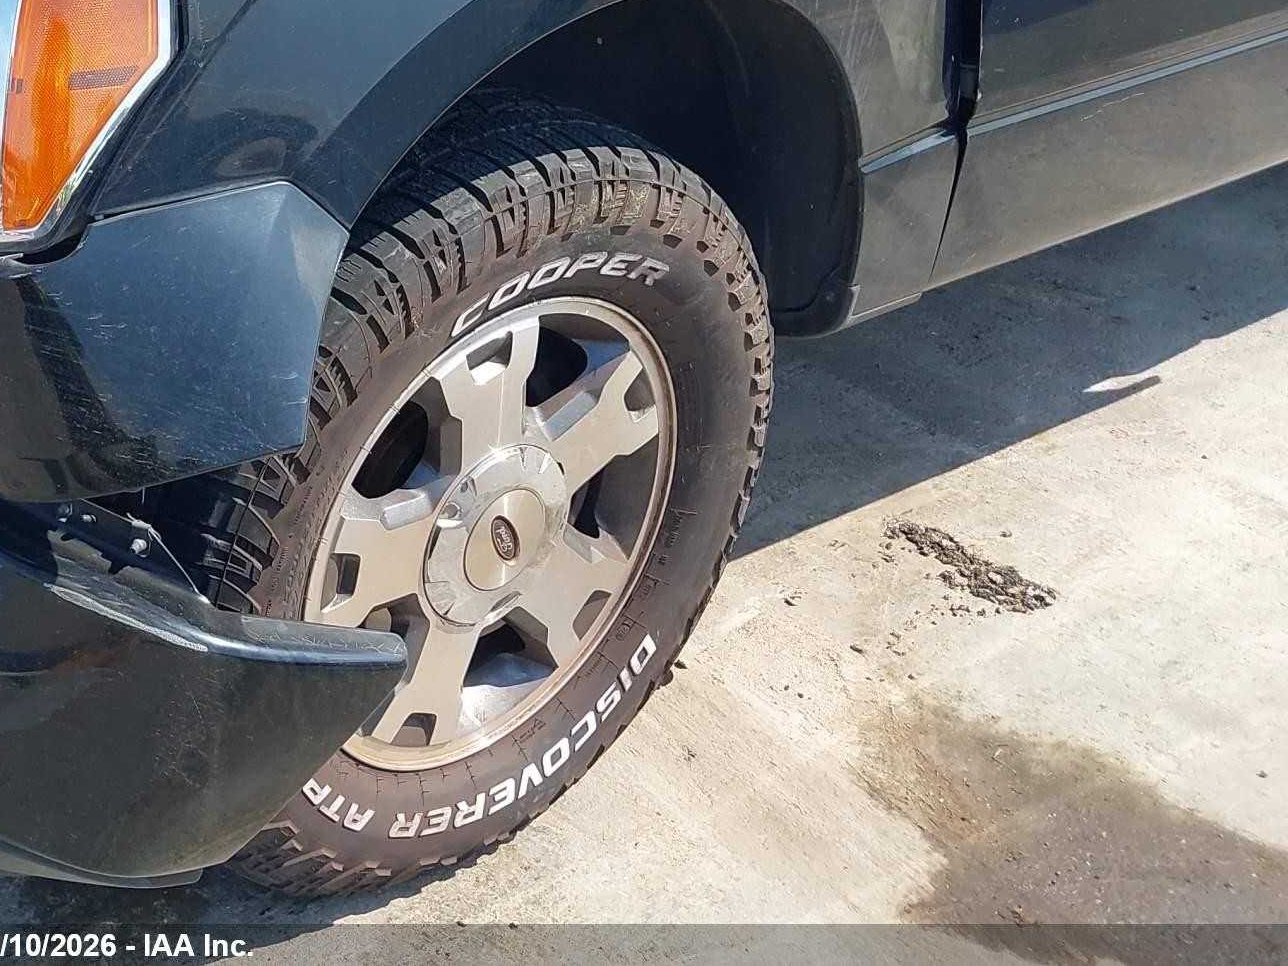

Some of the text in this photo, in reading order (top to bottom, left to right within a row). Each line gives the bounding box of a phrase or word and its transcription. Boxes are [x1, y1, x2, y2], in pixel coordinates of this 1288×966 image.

[450, 251, 670, 337] COOPER
[301, 633, 658, 839] DISCOVERER ATP
